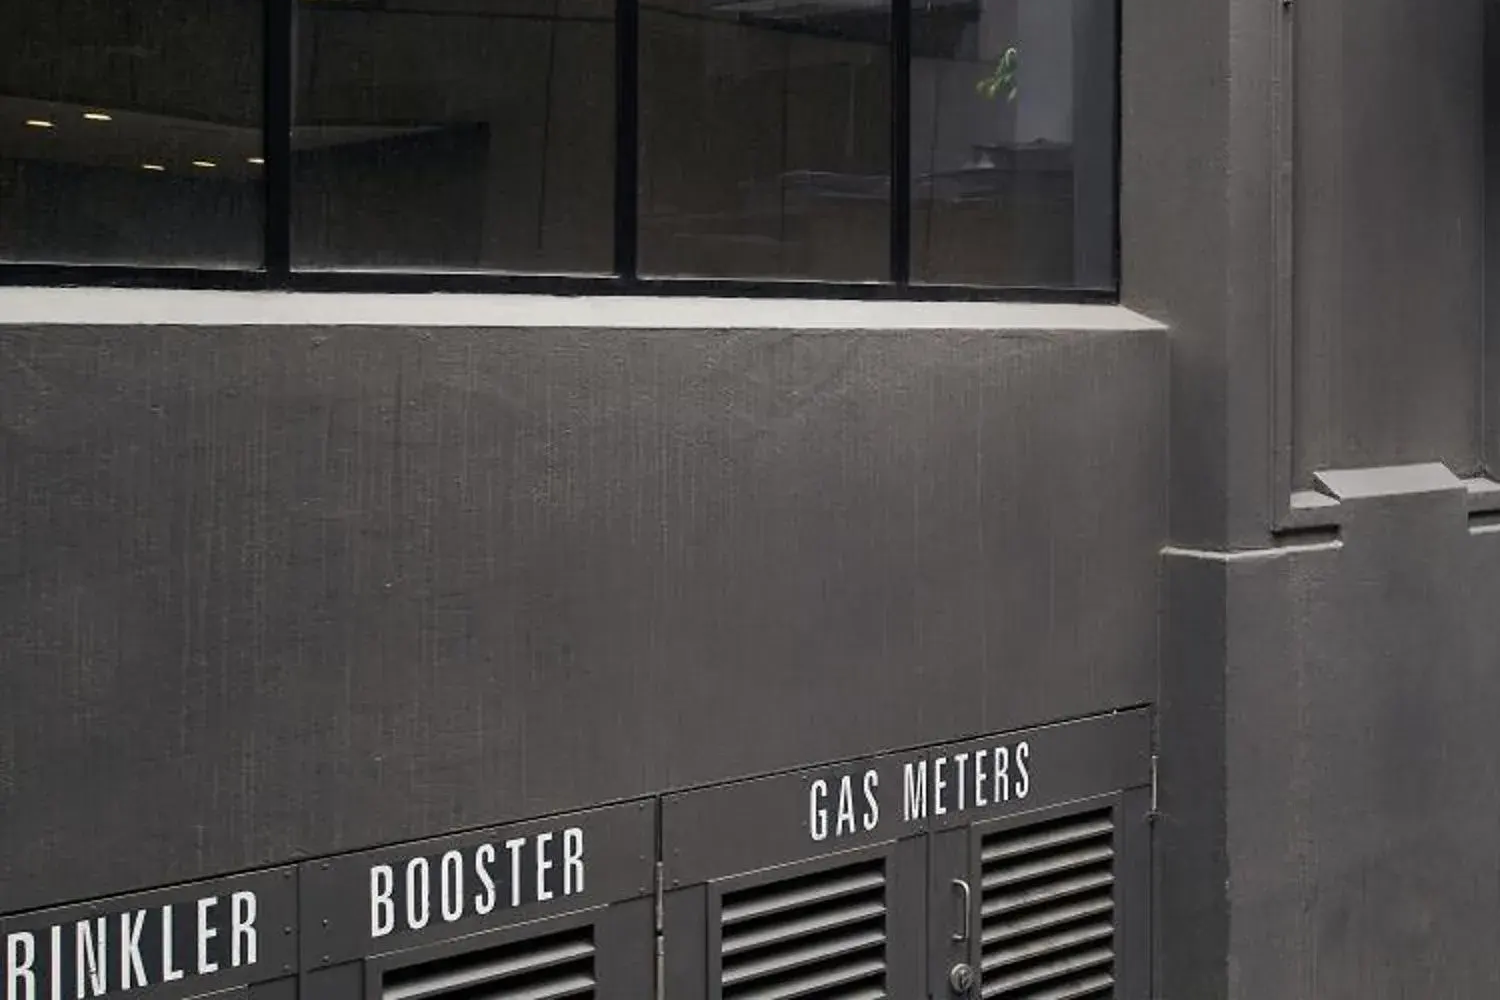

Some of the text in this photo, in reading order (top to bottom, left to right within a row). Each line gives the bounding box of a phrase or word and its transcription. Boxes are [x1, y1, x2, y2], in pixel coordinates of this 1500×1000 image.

[808, 741, 1030, 842] GAS METERS
[7, 827, 585, 1000] RINKLER BOOSTER
